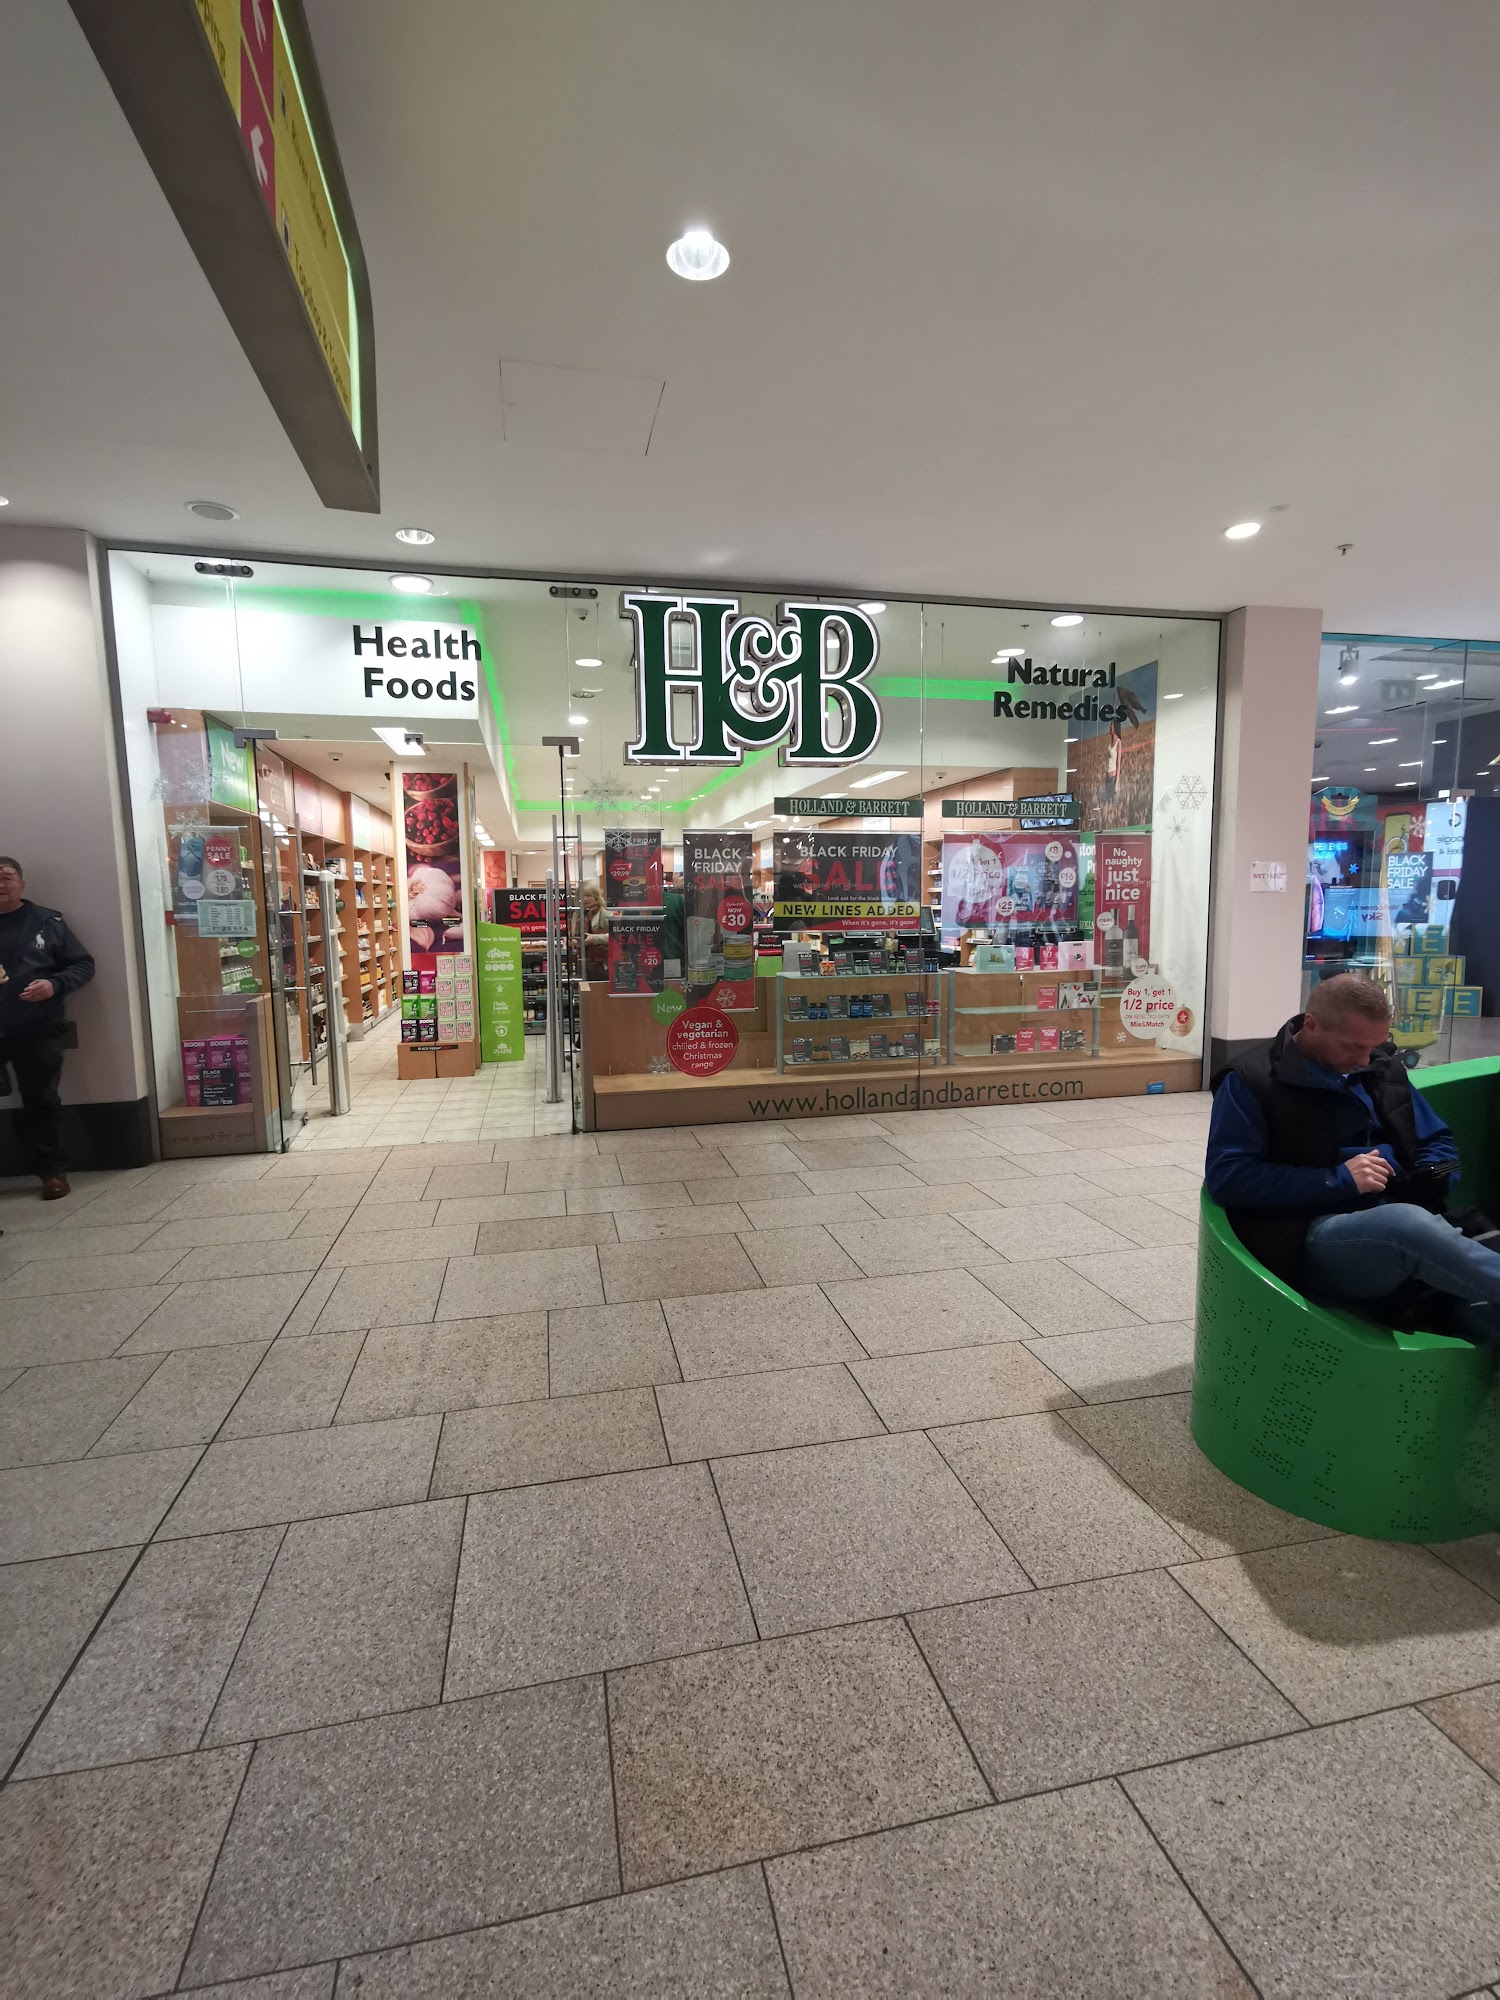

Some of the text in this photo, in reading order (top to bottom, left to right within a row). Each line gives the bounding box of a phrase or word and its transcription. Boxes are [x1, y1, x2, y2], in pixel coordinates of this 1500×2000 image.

[353, 625, 481, 661] Health
[1007, 657, 1116, 688] Natural
[364, 667, 475, 701] Foods
[993, 691, 1128, 723] Remedies
[790, 800, 910, 816] HOLLAND & BARRETT
[956, 801, 1067, 818] HOLLAND & BARRETT
[208, 852, 232, 860] SALE
[694, 848, 742, 859] BLACK
[800, 846, 898, 858] BLACK FRIDAY
[1049, 846, 1059, 854] £8
[1113, 848, 1127, 856] No
[1105, 856, 1142, 867] naughty
[1388, 854, 1426, 866] BLACK
[694, 862, 742, 873] FRIDAY
[1388, 866, 1428, 877] FRIDAY
[800, 859, 896, 892] SALE
[1107, 866, 1139, 887] just
[694, 874, 742, 890] SALE
[1388, 878, 1414, 889] SALE
[1105, 884, 1140, 901] nice
[783, 904, 914, 916] NEW LINES ADDED
[722, 914, 746, 926] £30
[618, 934, 654, 945] SALE
[1128, 988, 1141, 997] Buy
[1123, 999, 1174, 1013] 1/2 price
[1415, 992, 1432, 1011] E
[1454, 992, 1471, 1013] E
[657, 1003, 682, 1014] New
[682, 1020, 723, 1031] Vegan &
[677, 1029, 728, 1040] vegetarian
[672, 1042, 698, 1050] chilled
[684, 1052, 722, 1060] Christmas
[748, 1080, 1084, 1115] www.hollandandbarrett.com
